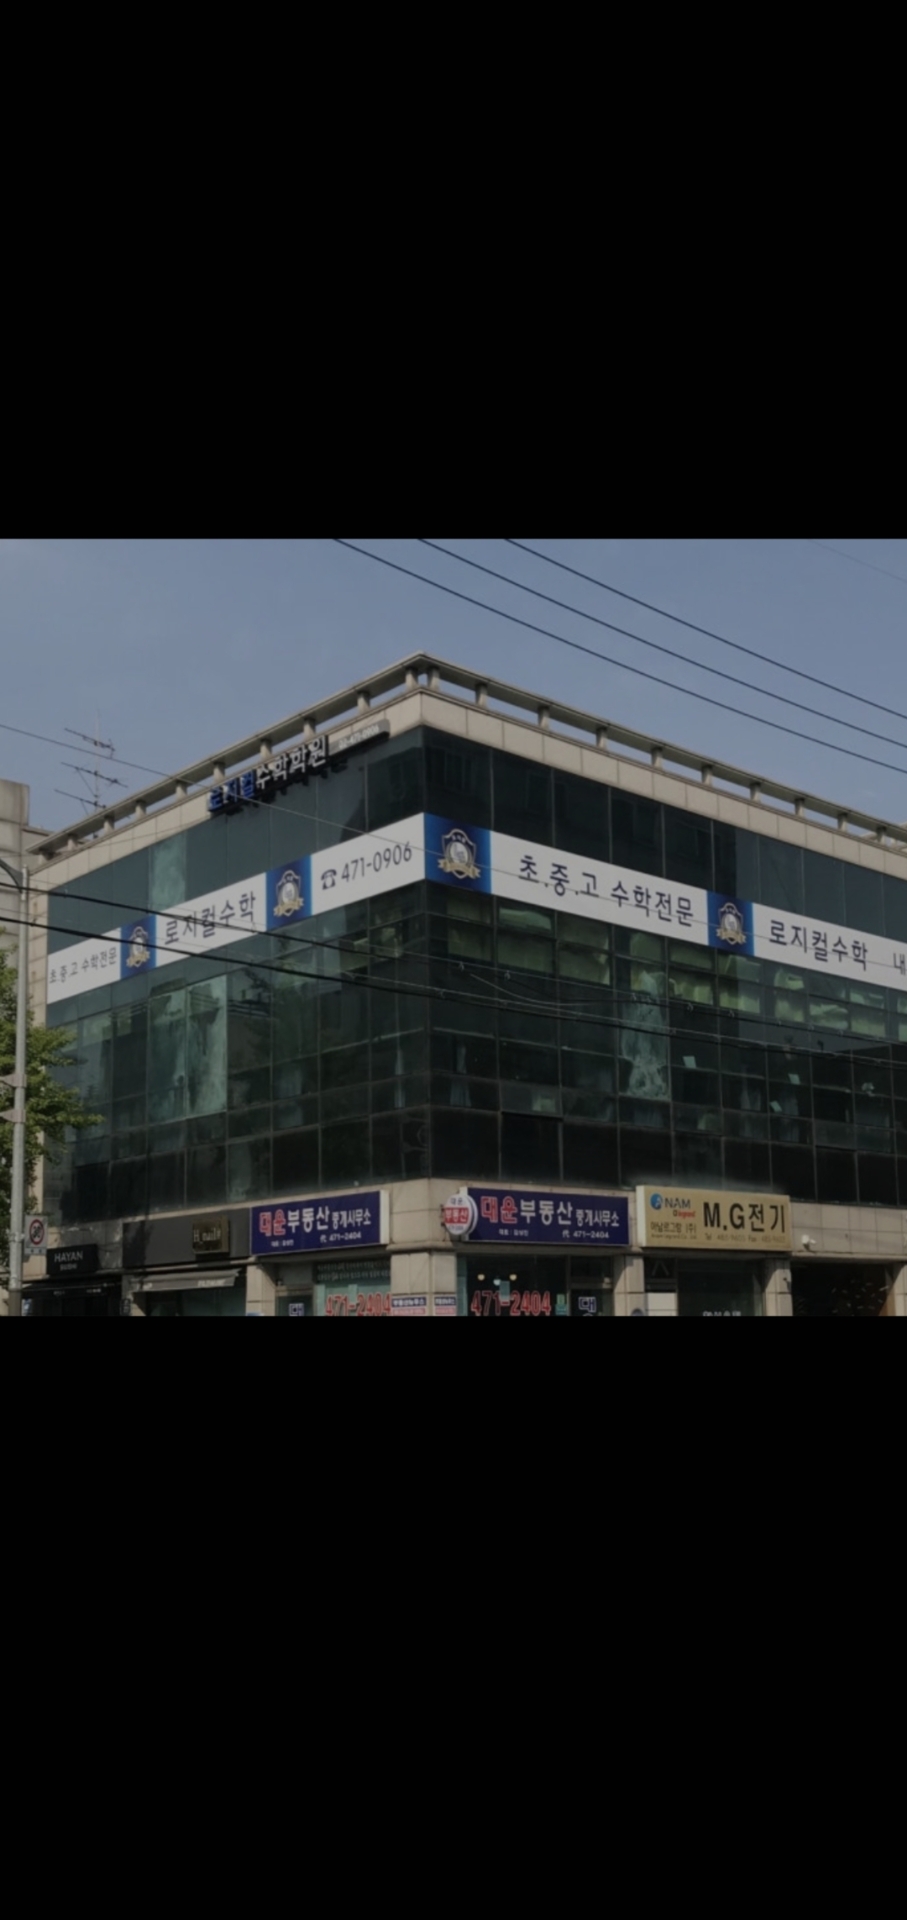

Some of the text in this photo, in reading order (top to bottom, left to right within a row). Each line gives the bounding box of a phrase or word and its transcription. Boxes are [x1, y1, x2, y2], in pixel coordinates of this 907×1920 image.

[208, 735, 326, 811] 로지컬수학학원
[341, 842, 412, 882] 471-0906
[610, 881, 693, 927] 수학전문
[164, 892, 256, 946] 로지컬수학
[769, 920, 868, 972] 로지컬수학
[445, 1208, 468, 1223] 부동산
[329, 1231, 362, 1241] 471-2404
[573, 1230, 609, 1239] 471-2404
[54, 1250, 84, 1263] HAYAN
[325, 1291, 391, 1316] 471-2404
[470, 1291, 552, 1316] 471-2404
